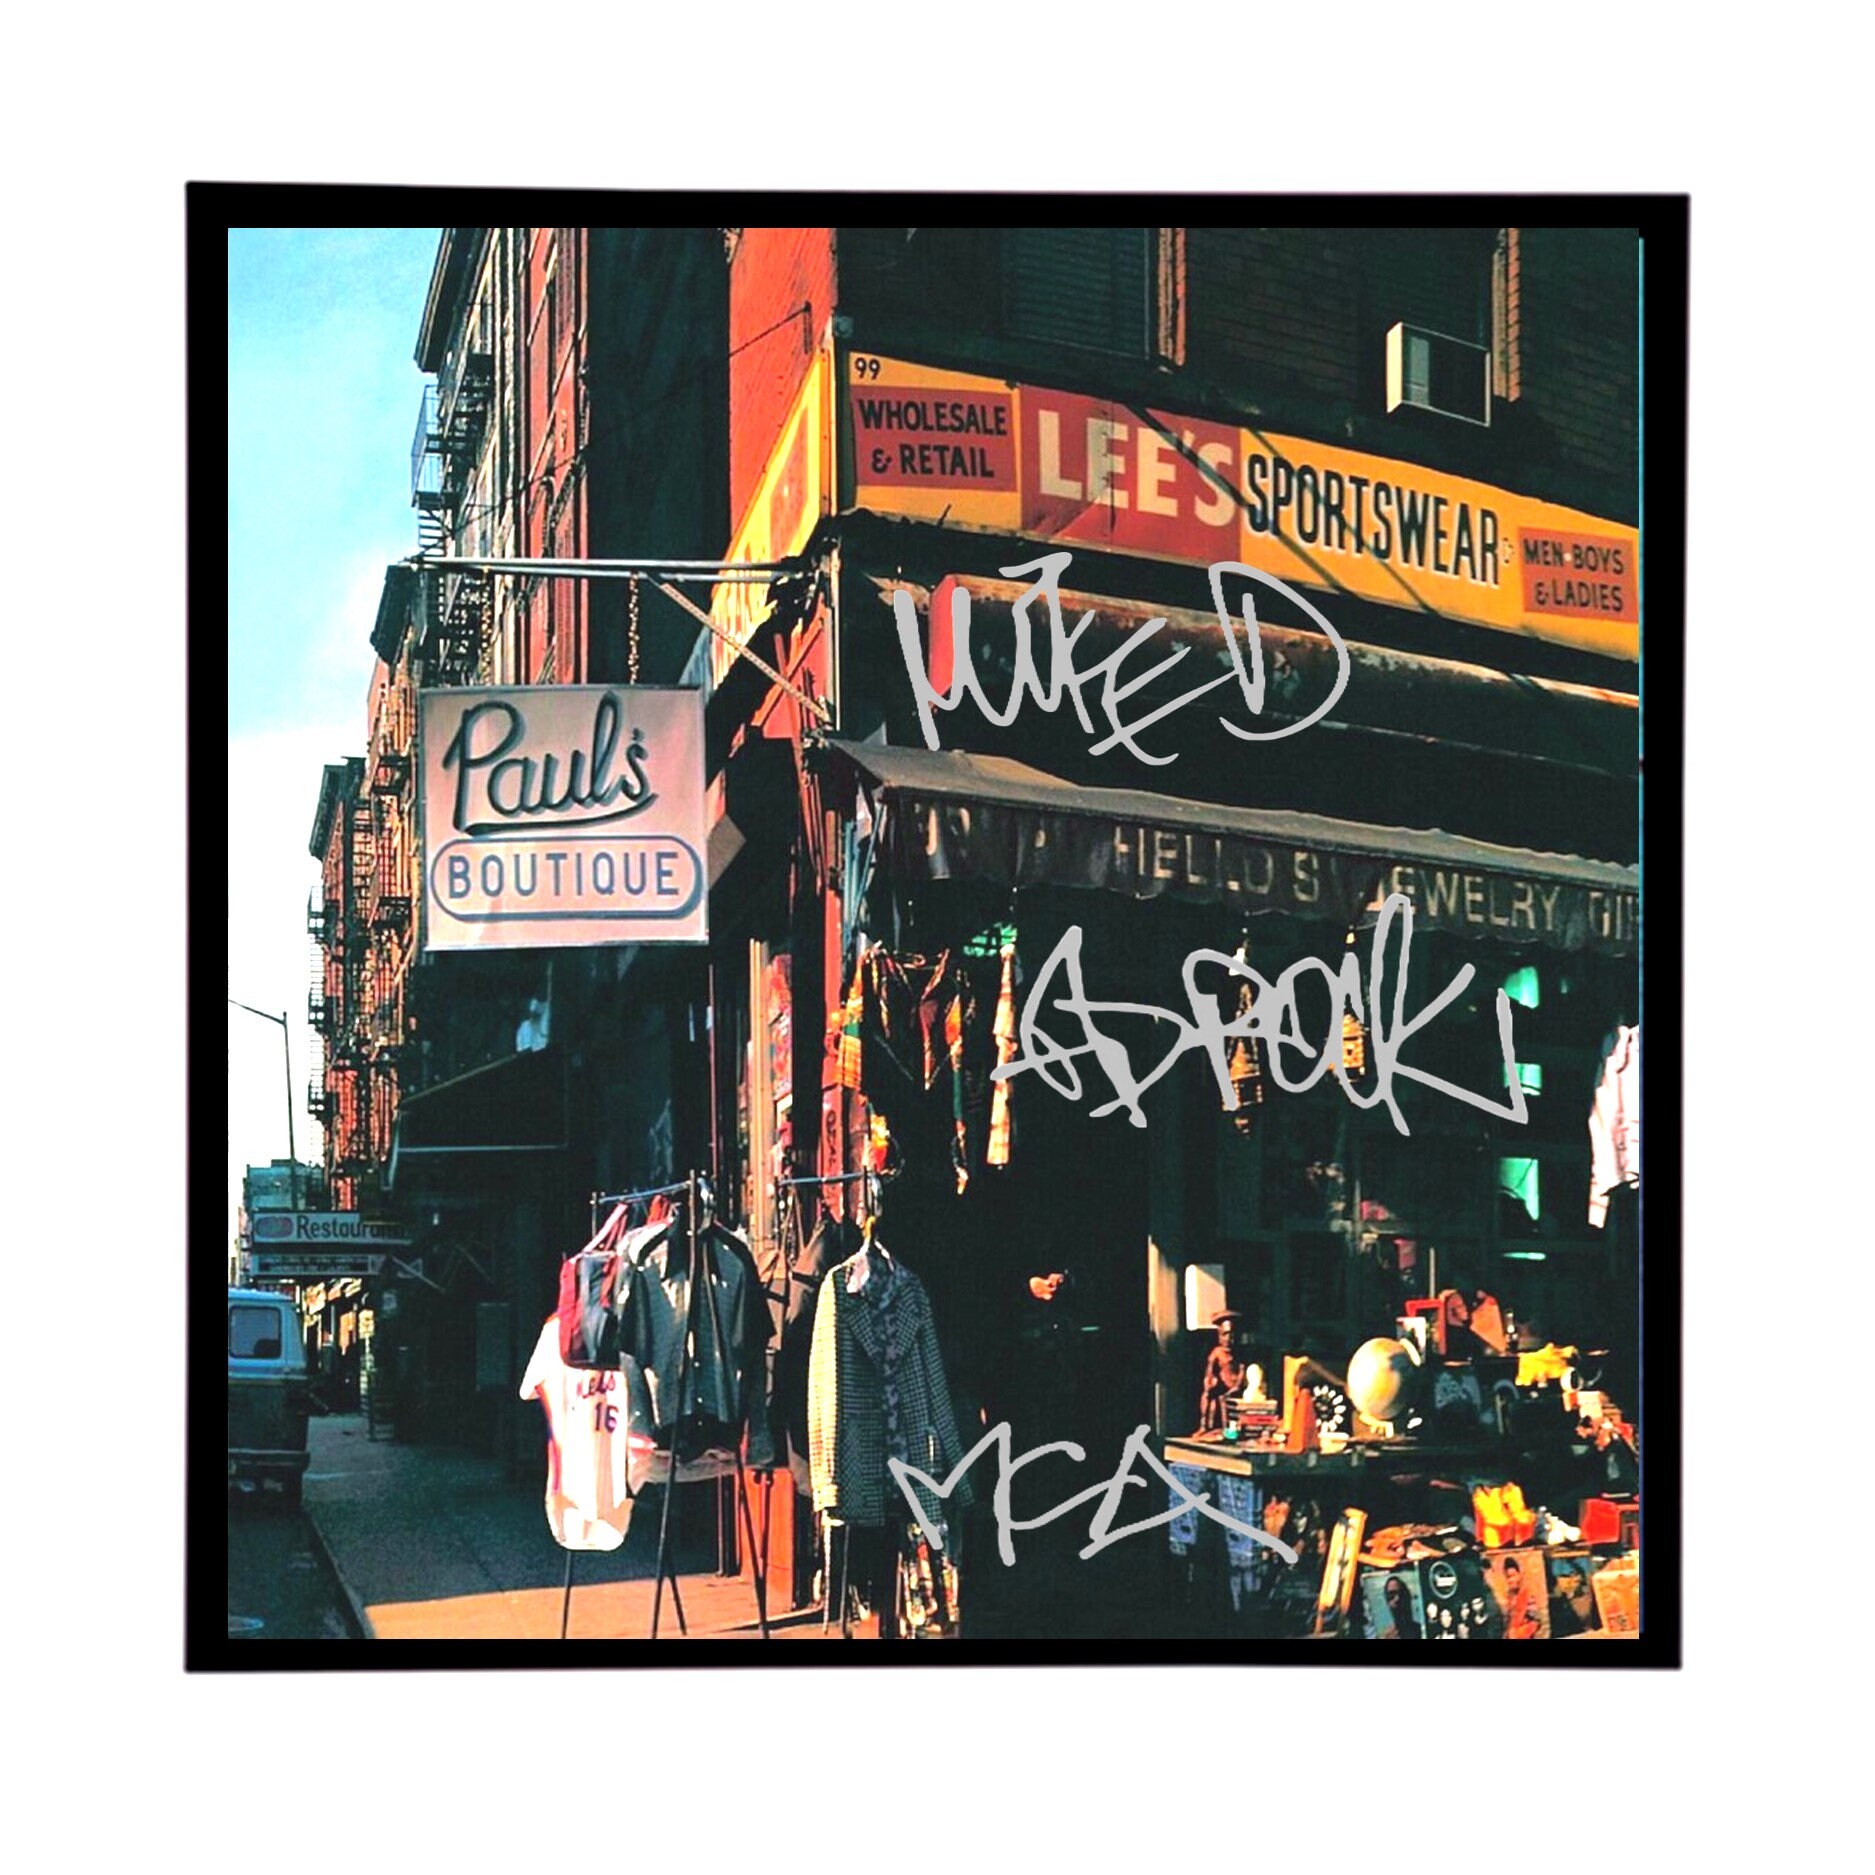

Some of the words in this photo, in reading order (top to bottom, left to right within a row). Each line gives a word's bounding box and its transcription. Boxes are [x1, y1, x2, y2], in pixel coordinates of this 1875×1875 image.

[855, 357, 881, 379] 99
[859, 399, 1008, 437] WHOLESALE
[872, 447, 892, 474] &
[899, 444, 995, 478] RETAIL
[1038, 409, 1236, 527] LEE'S
[1246, 453, 1500, 588] SPORTSWEAR
[1552, 579, 1623, 613] LADIES
[442, 690, 658, 839] Paul's
[447, 851, 680, 900] BOUTIQUE
[595, 1402, 619, 1434] 16
[888, 1421, 1299, 1567] MCA
